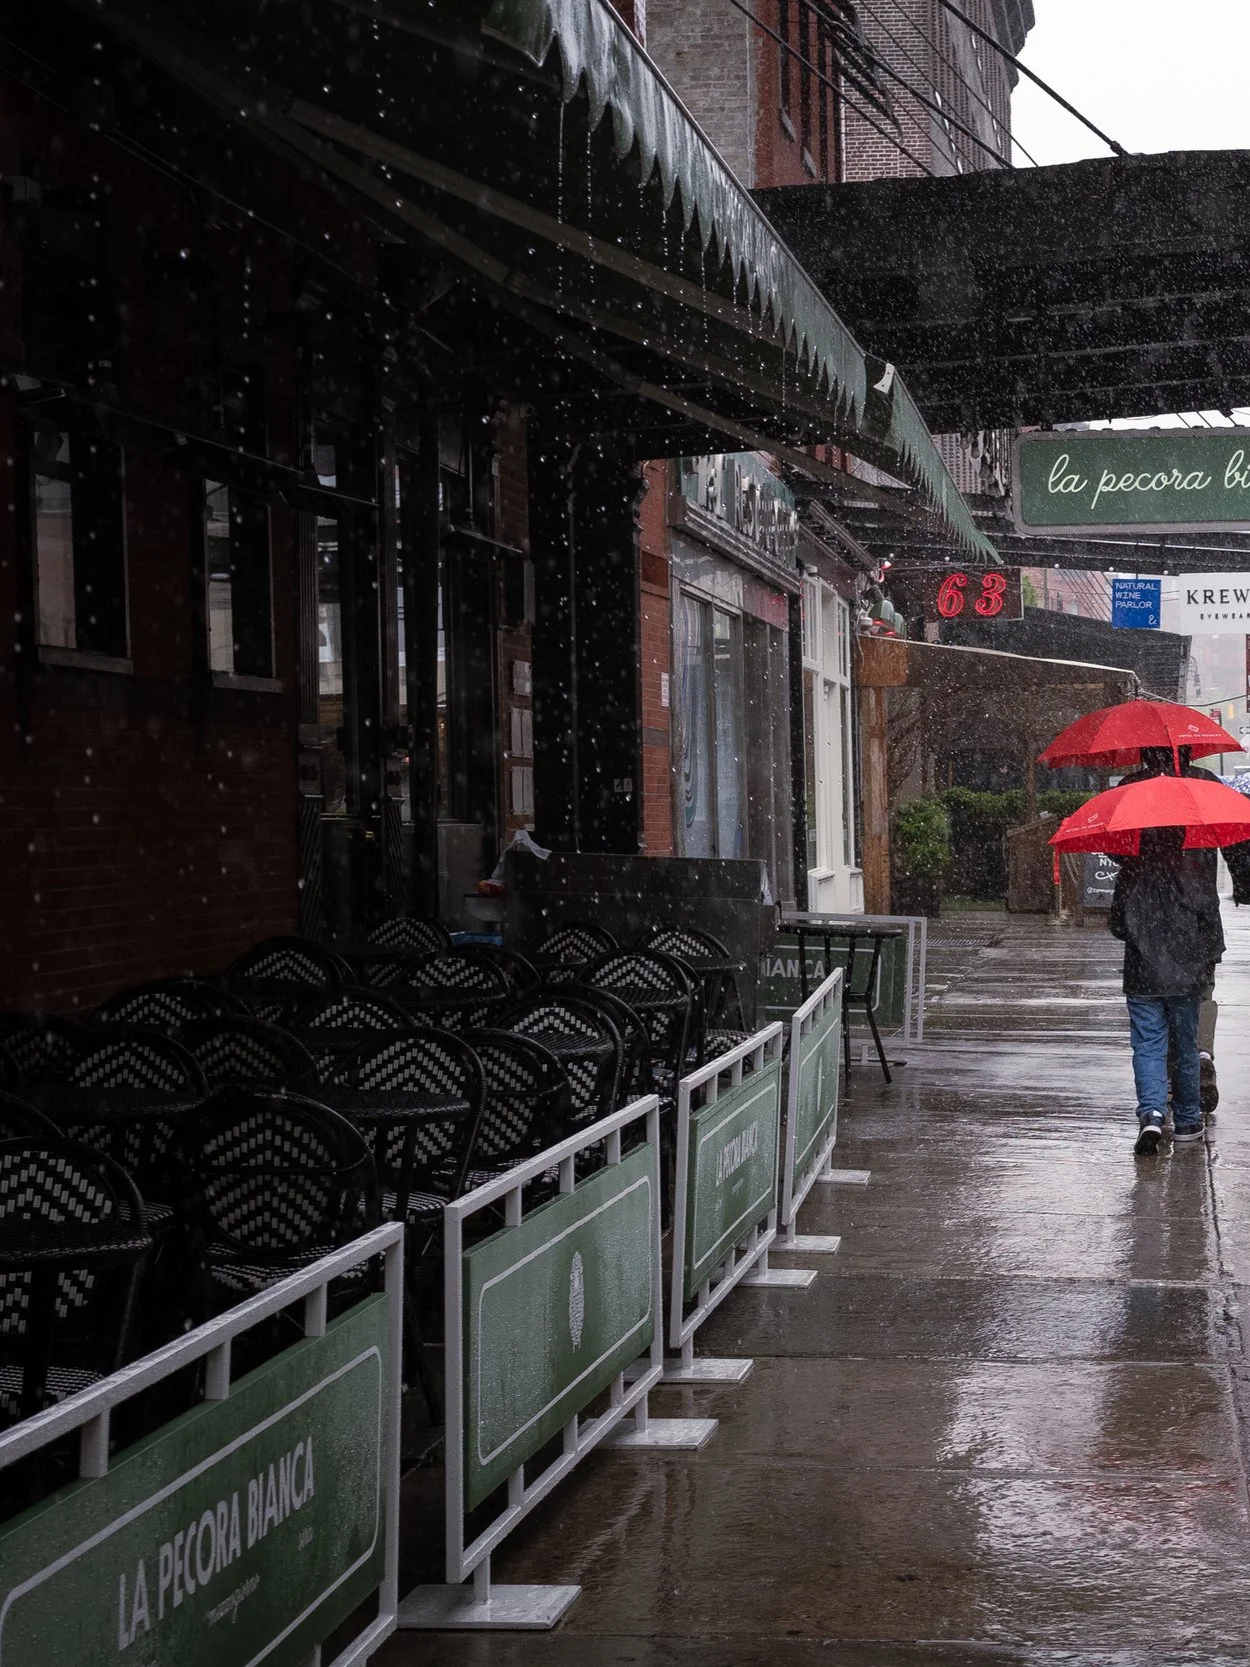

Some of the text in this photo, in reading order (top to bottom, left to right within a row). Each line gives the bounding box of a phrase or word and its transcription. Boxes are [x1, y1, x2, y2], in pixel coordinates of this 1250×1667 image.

[1048, 454, 1088, 493] la
[1091, 468, 1212, 509] pecora
[938, 573, 1006, 617] 63
[1115, 582, 1158, 590] NATURAL
[1115, 591, 1141, 599] WINE
[1115, 601, 1153, 609] PARLOR
[118, 1559, 150, 1651] LA
[158, 1491, 242, 1621] PECORA
[247, 1435, 315, 1550] BIANCA
